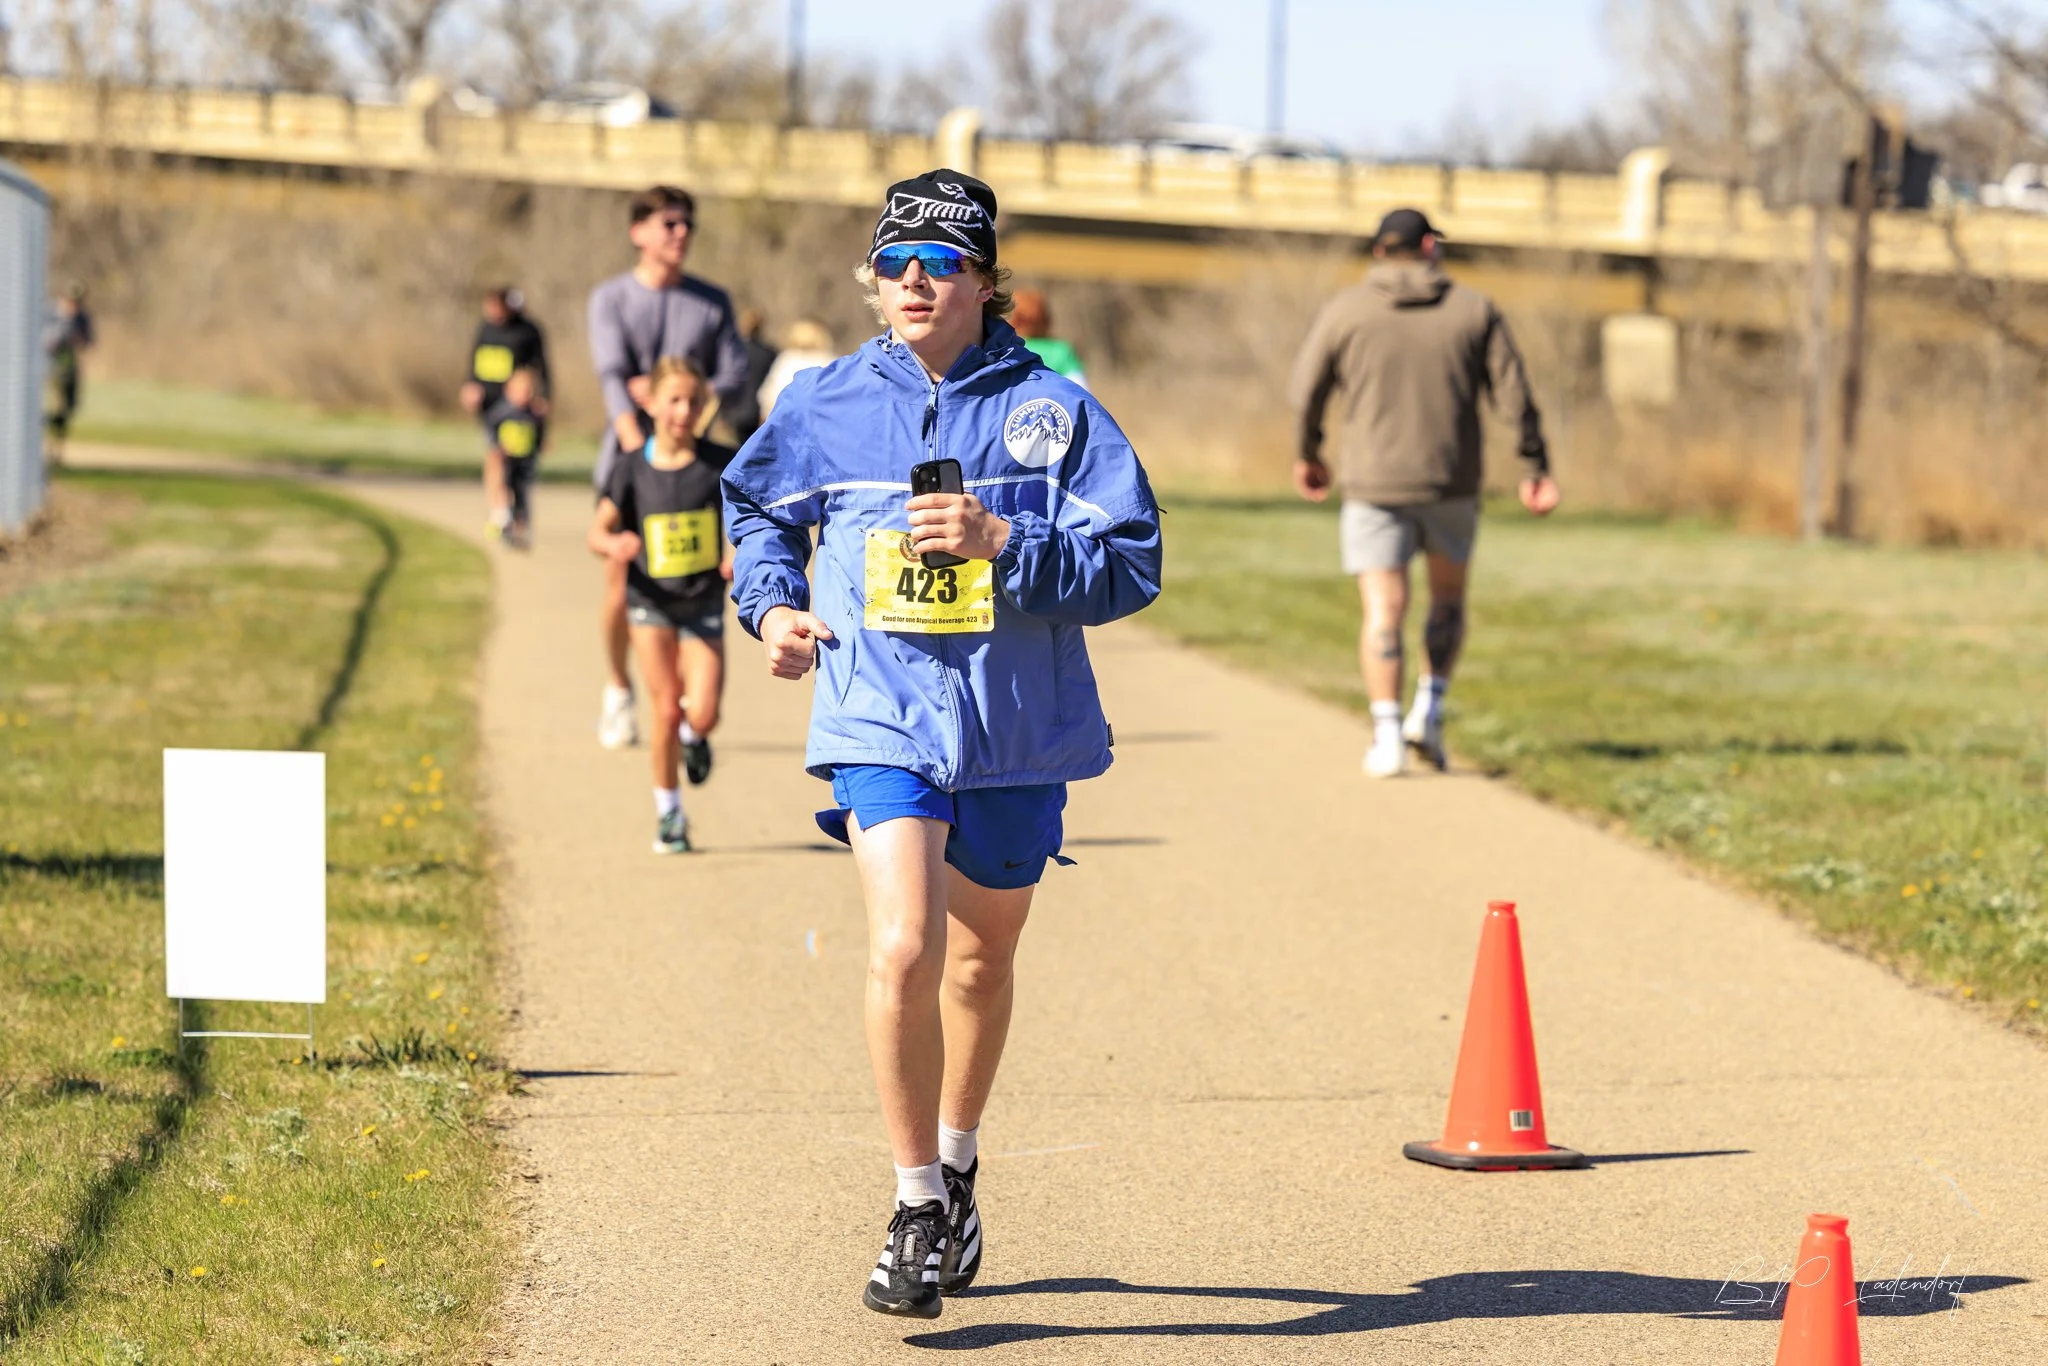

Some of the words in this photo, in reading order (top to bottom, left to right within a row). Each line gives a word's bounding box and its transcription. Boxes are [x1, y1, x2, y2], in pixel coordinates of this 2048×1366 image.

[1011, 403, 1046, 429] SUMMIT
[1048, 406, 1066, 433] BROS
[896, 567, 958, 604] 423
[916, 616, 937, 625] Atypical
[938, 617, 965, 625] Beverage
